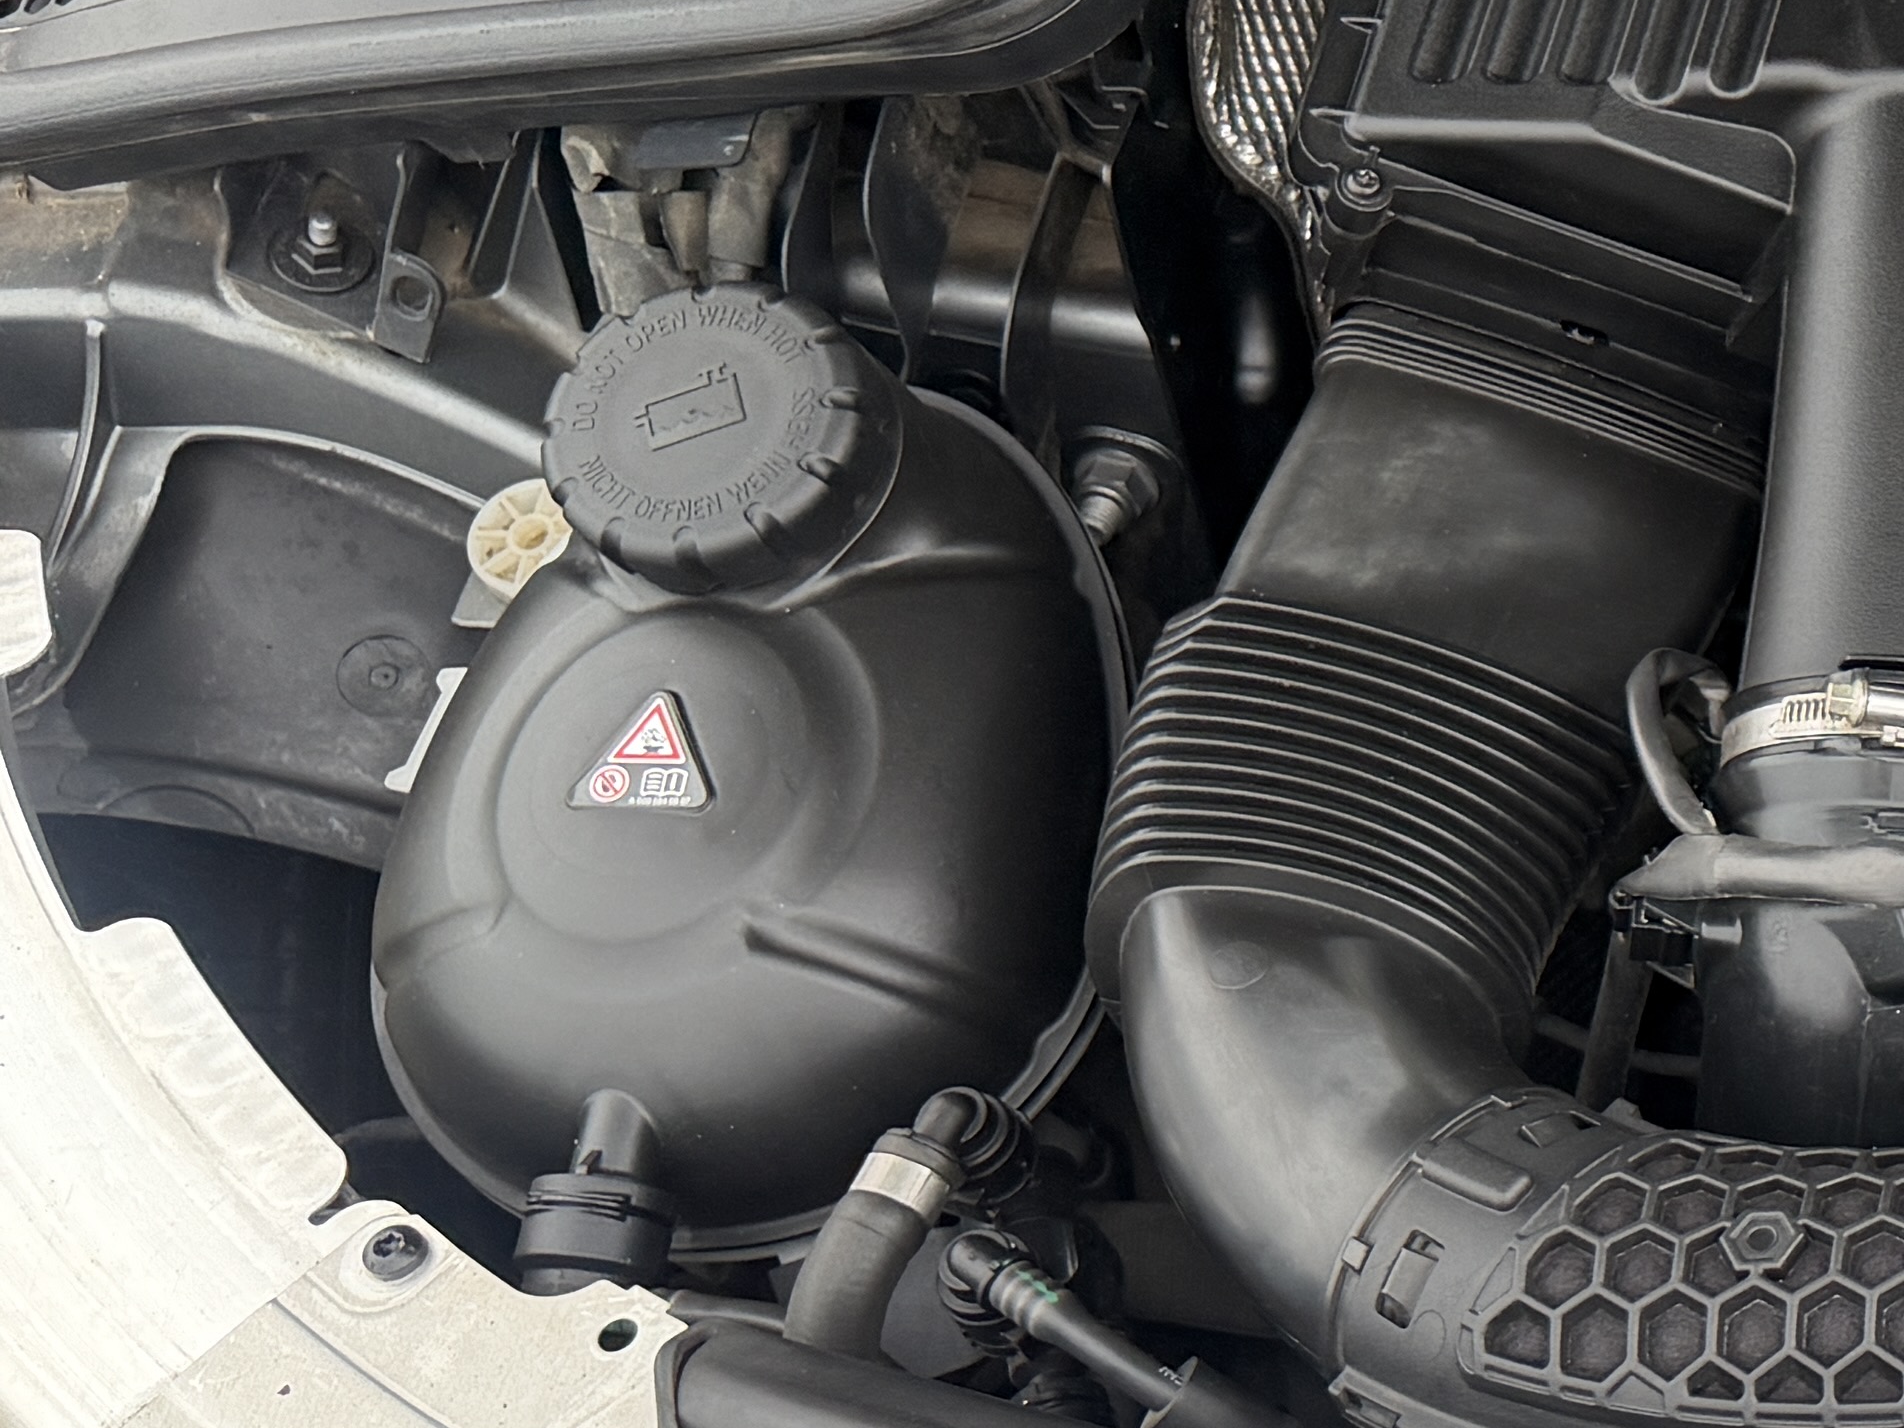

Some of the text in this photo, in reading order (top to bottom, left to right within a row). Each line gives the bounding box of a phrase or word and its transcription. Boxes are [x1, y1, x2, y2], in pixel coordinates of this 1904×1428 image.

[573, 402, 598, 432] DO
[626, 310, 687, 353] OPEN
[698, 304, 767, 337] WHEN
[771, 324, 806, 364] HOT
[579, 454, 636, 510] NICHT
[725, 450, 793, 505] WENN
